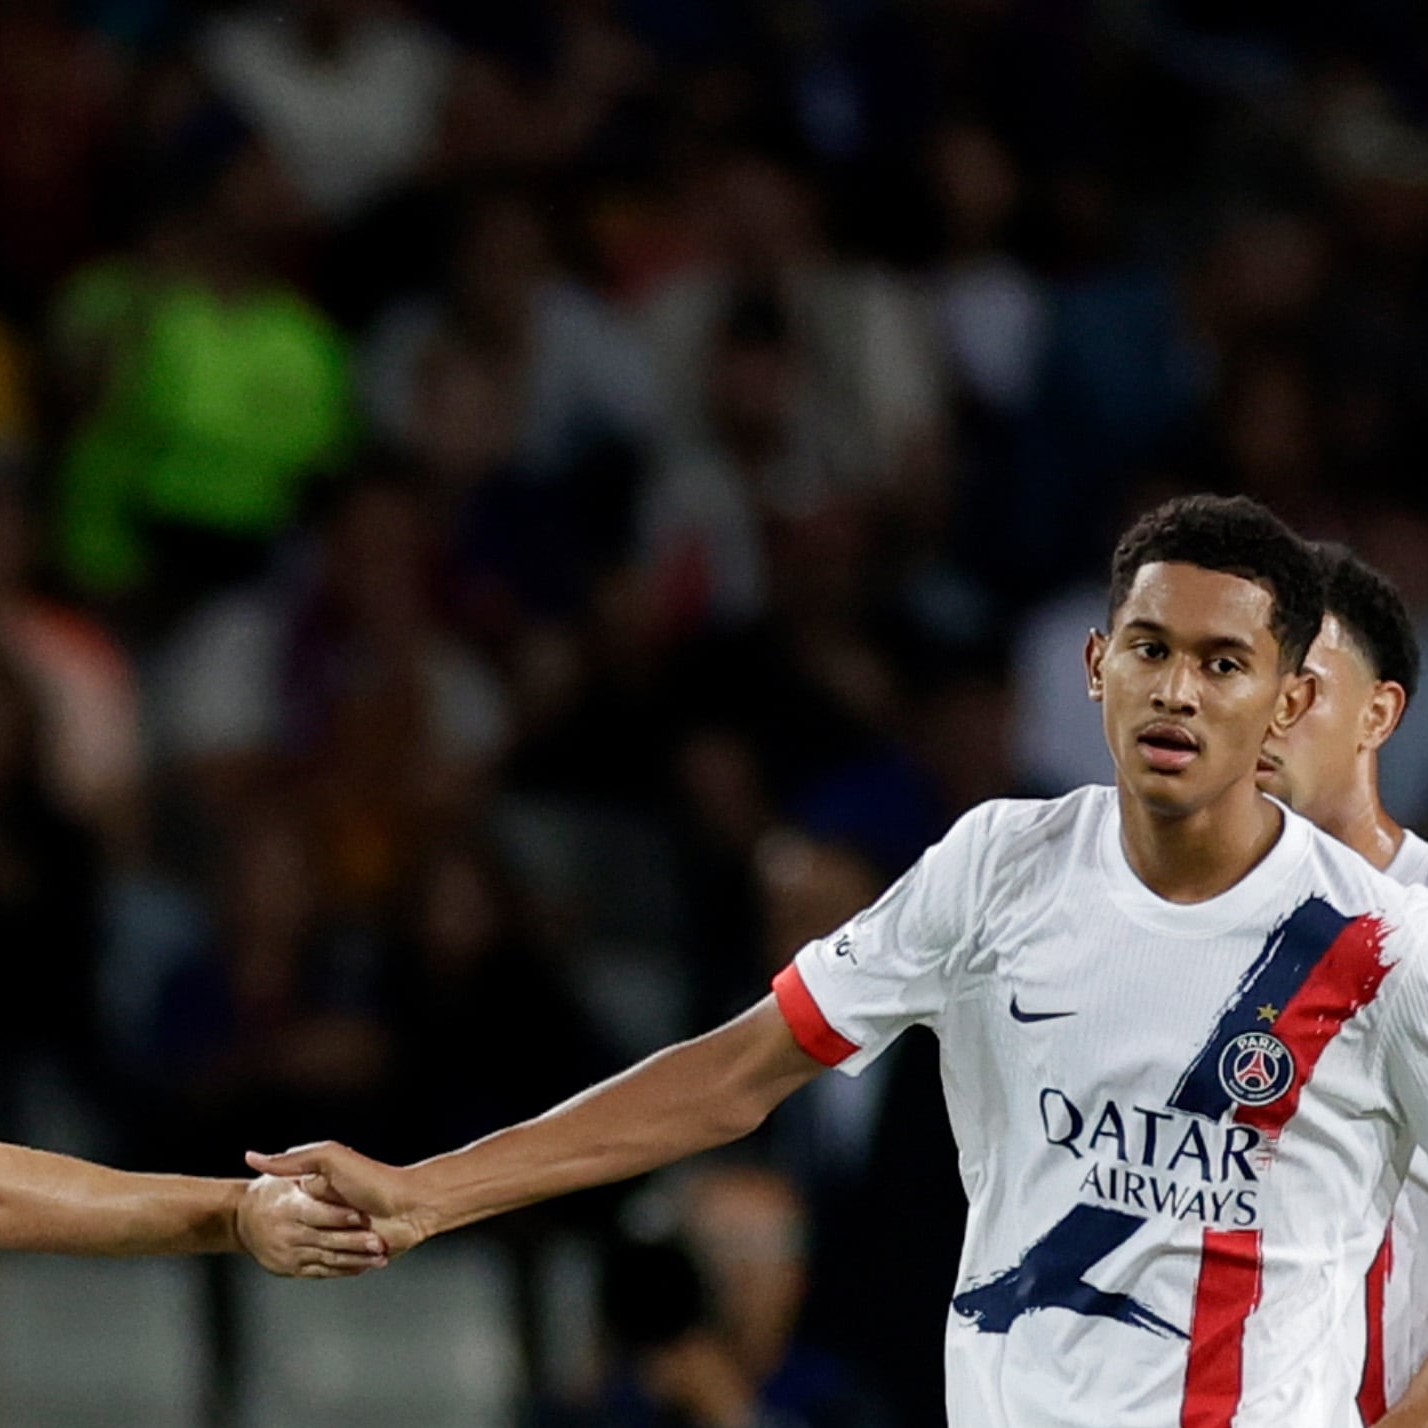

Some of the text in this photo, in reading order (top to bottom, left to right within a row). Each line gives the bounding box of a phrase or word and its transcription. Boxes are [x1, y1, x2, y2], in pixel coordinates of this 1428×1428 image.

[1236, 1035, 1285, 1059] PARIS
[1039, 1087, 1260, 1184] QATAR
[1080, 1162, 1258, 1227] AIRWAYS
